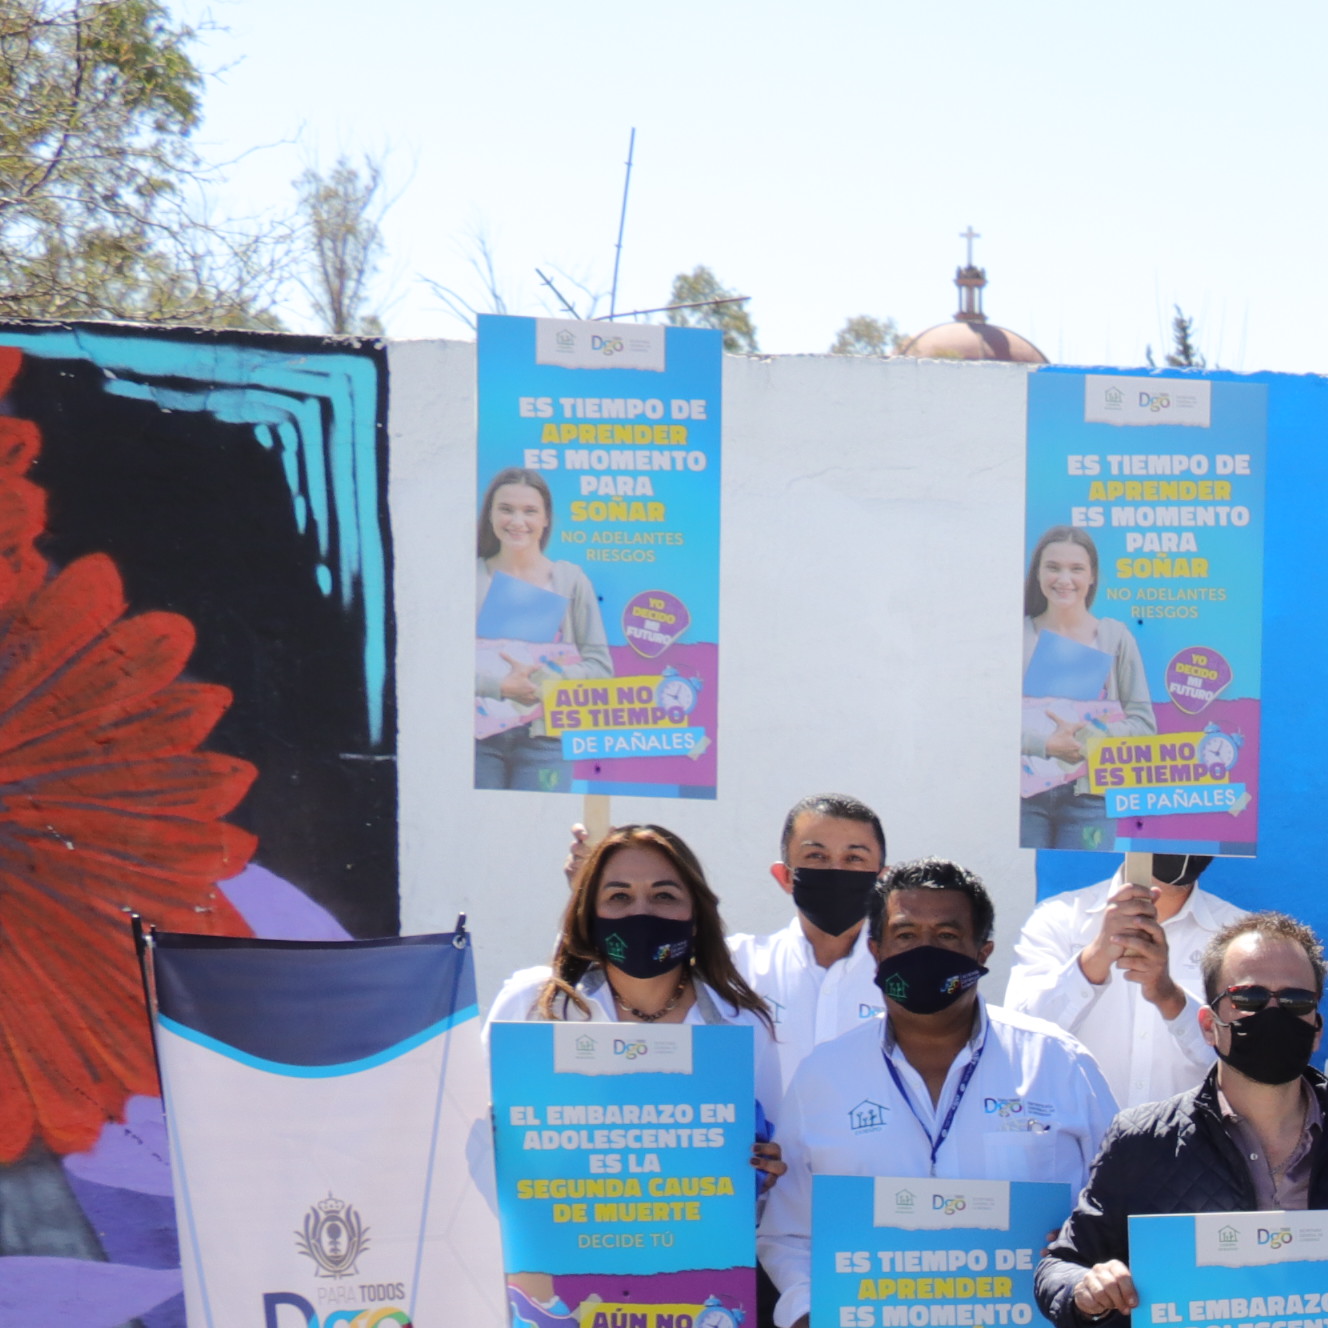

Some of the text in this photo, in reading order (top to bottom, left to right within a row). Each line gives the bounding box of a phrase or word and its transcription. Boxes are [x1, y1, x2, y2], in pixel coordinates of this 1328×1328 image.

[518, 397, 707, 420] ES TIEMPO DE
[541, 423, 687, 445] APRENDER
[523, 448, 707, 472] ES MOMENTO
[560, 529, 684, 546] NO ADELANTES
[1125, 532, 1197, 552] PARA
[585, 548, 655, 562] RIESGOS
[1115, 551, 1209, 579] SOÑAR
[1099, 741, 1195, 765] AÚN NO
[1093, 762, 1226, 787] ES TIEMPO
[1115, 785, 1236, 812] DE PAÑALES
[509, 1103, 735, 1126] EL EMBARAZO EN
[522, 1128, 724, 1150] ADOLESCENTES
[516, 1176, 734, 1199] SEGUNDA CAUSA
[835, 1249, 1033, 1273] ES TIEMPO DE
[317, 1282, 405, 1305] PARA TODOS
[857, 1277, 1012, 1300] APRENDER
